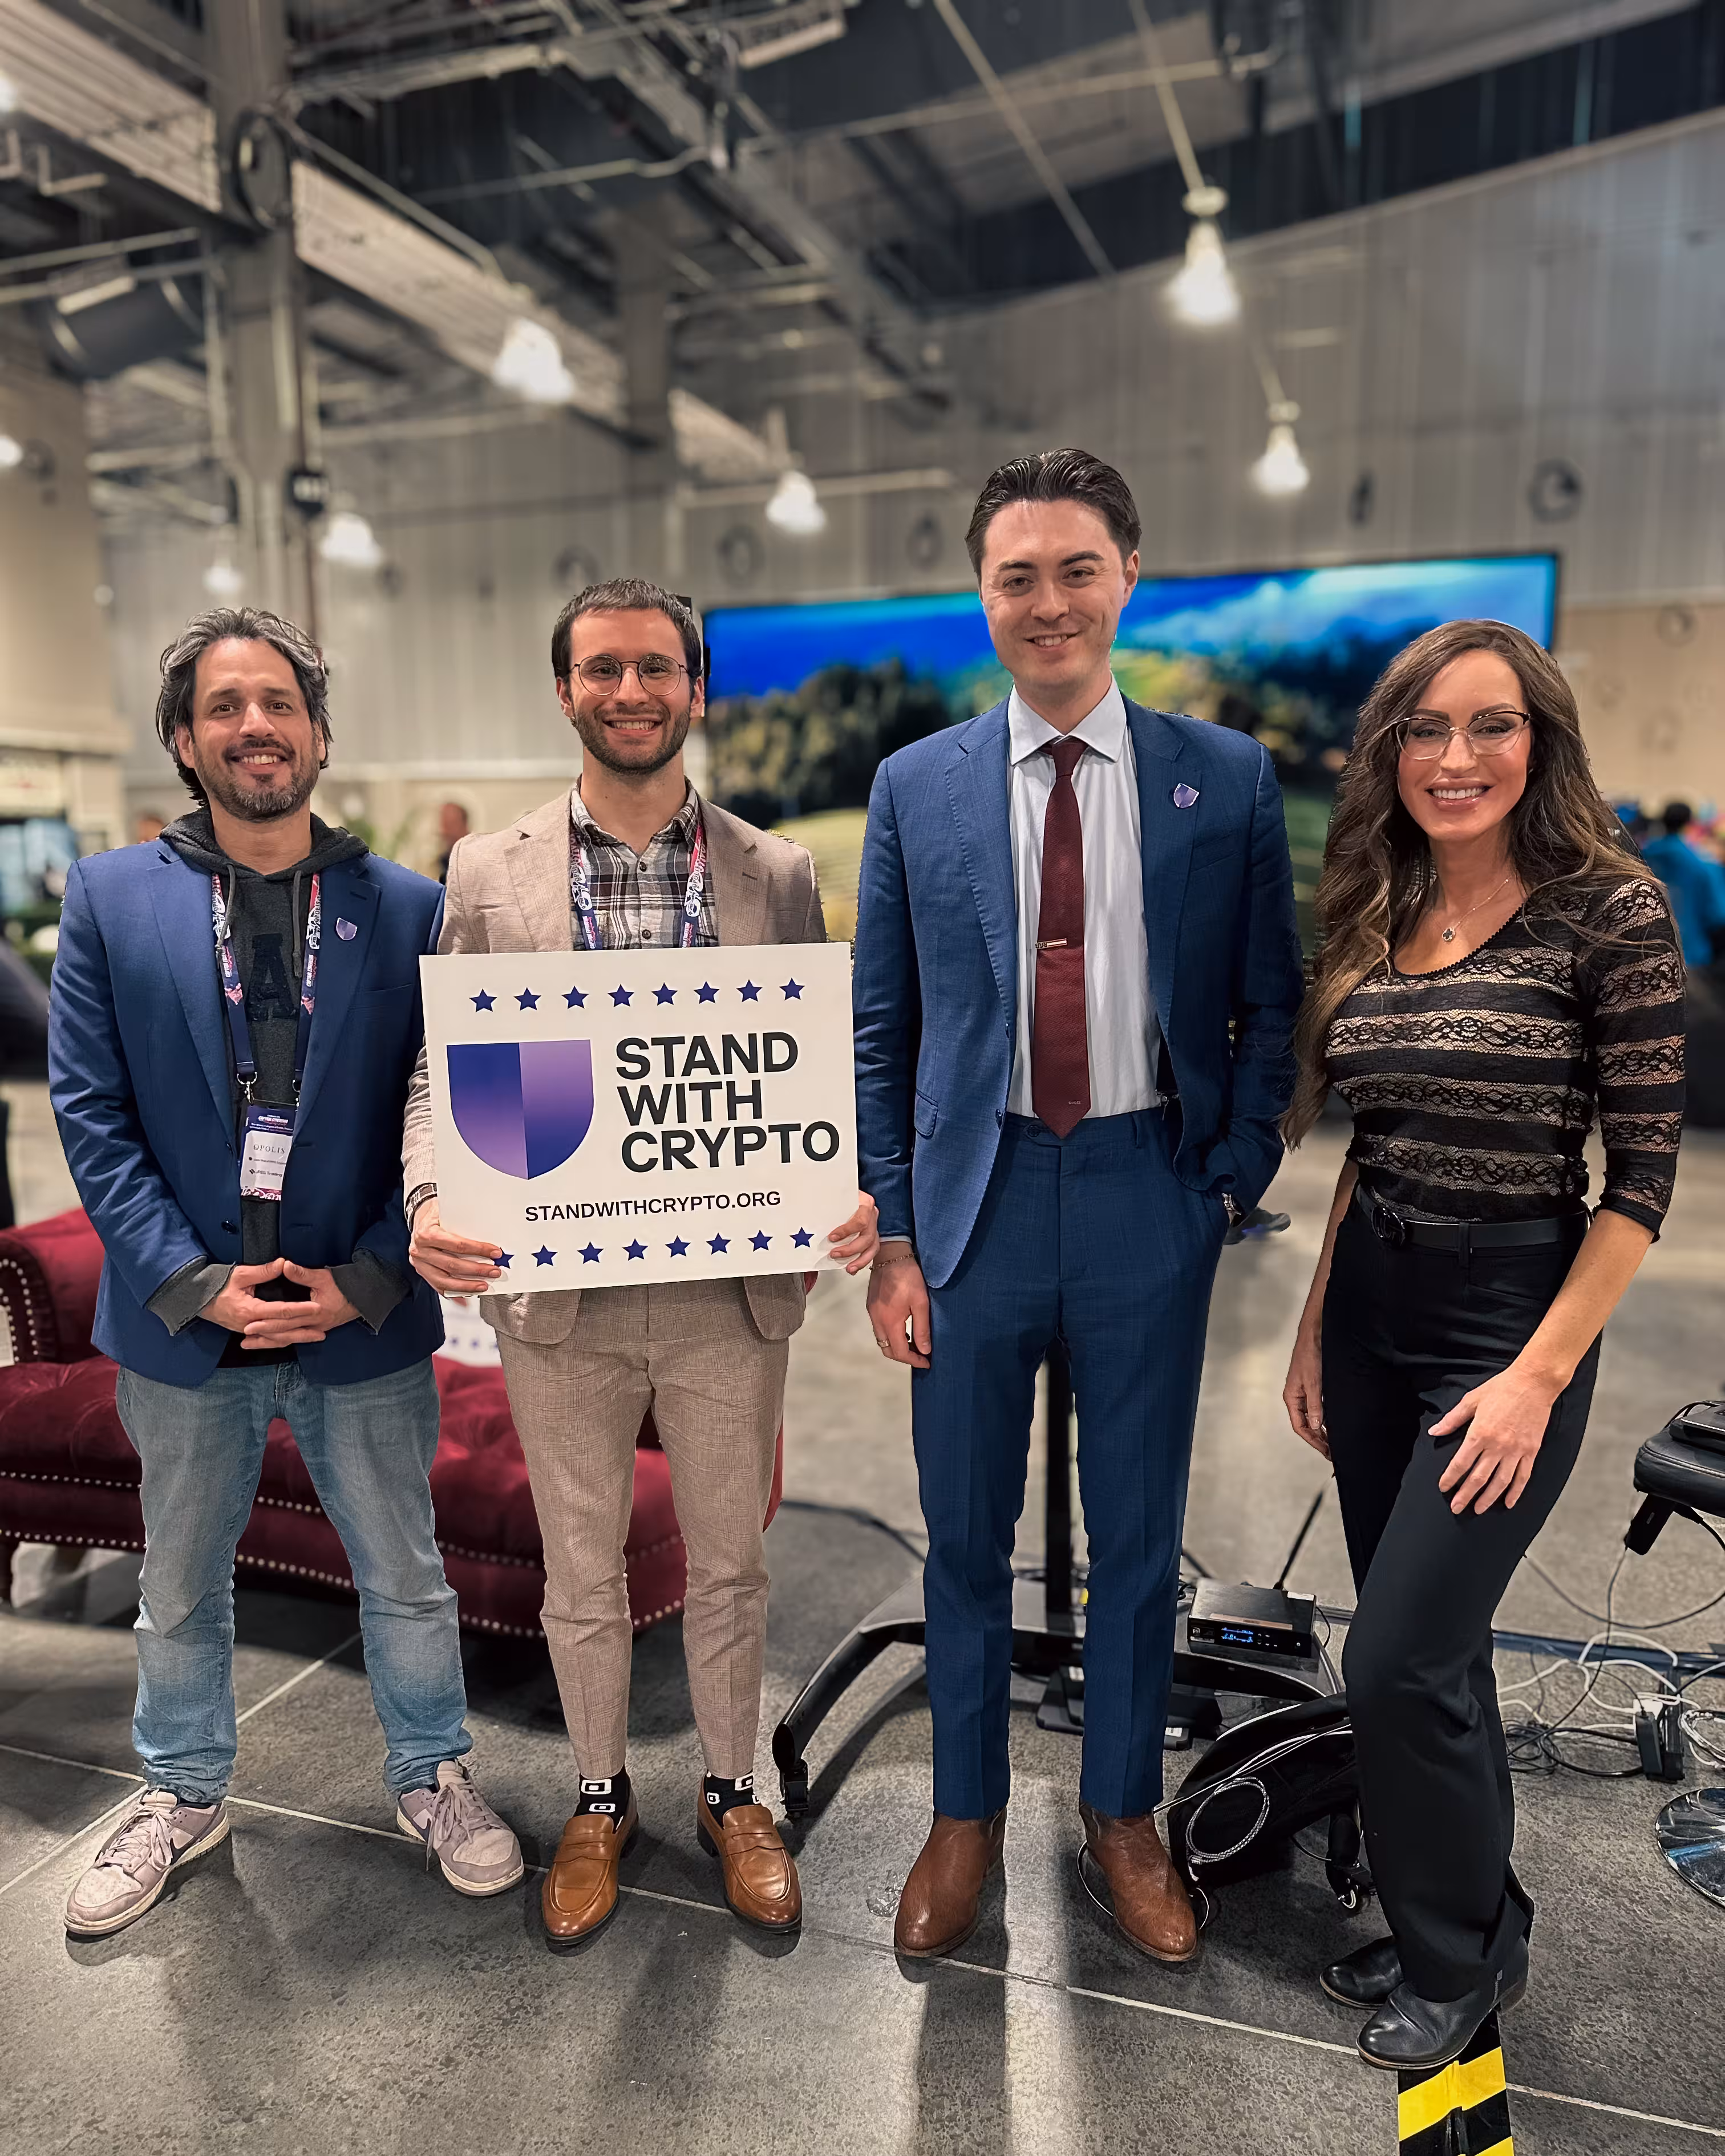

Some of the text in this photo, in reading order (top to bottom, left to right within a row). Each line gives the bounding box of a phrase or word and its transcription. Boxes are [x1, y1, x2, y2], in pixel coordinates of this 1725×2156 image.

[616, 1032, 797, 1080] STAND
[616, 1080, 762, 1126] WITH
[622, 1121, 839, 1173] CRYPTO
[526, 1192, 780, 1222] STANDWITHCRYPTO.ORG
